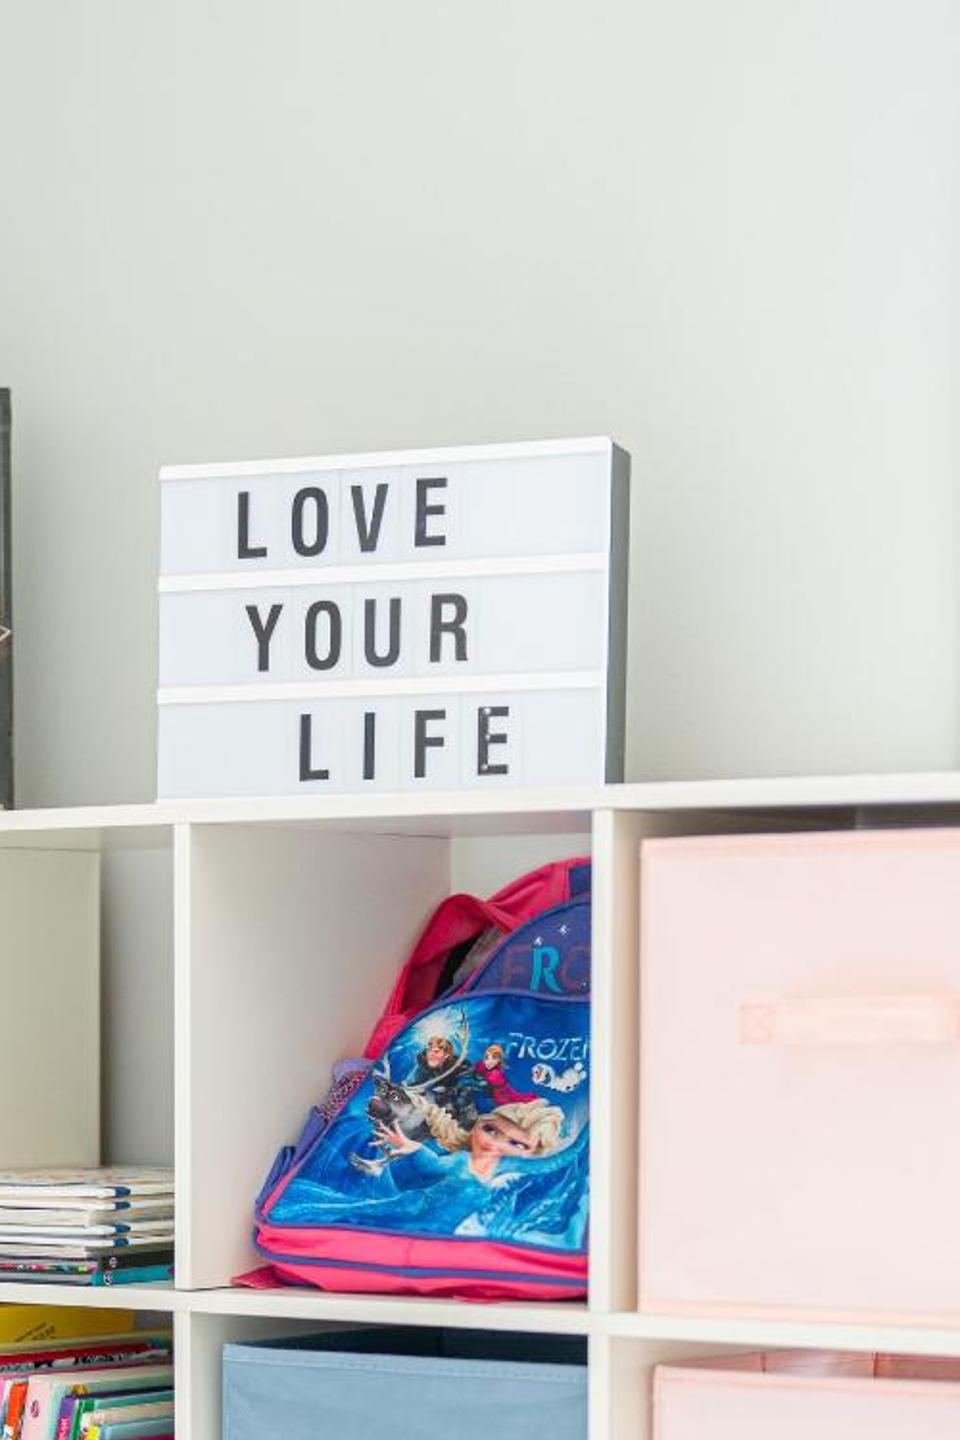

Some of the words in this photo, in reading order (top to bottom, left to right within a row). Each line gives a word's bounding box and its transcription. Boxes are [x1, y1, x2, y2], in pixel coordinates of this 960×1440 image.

[237, 477, 448, 559] LOVE
[245, 594, 468, 672] YOUR
[299, 706, 509, 782] LIFE
